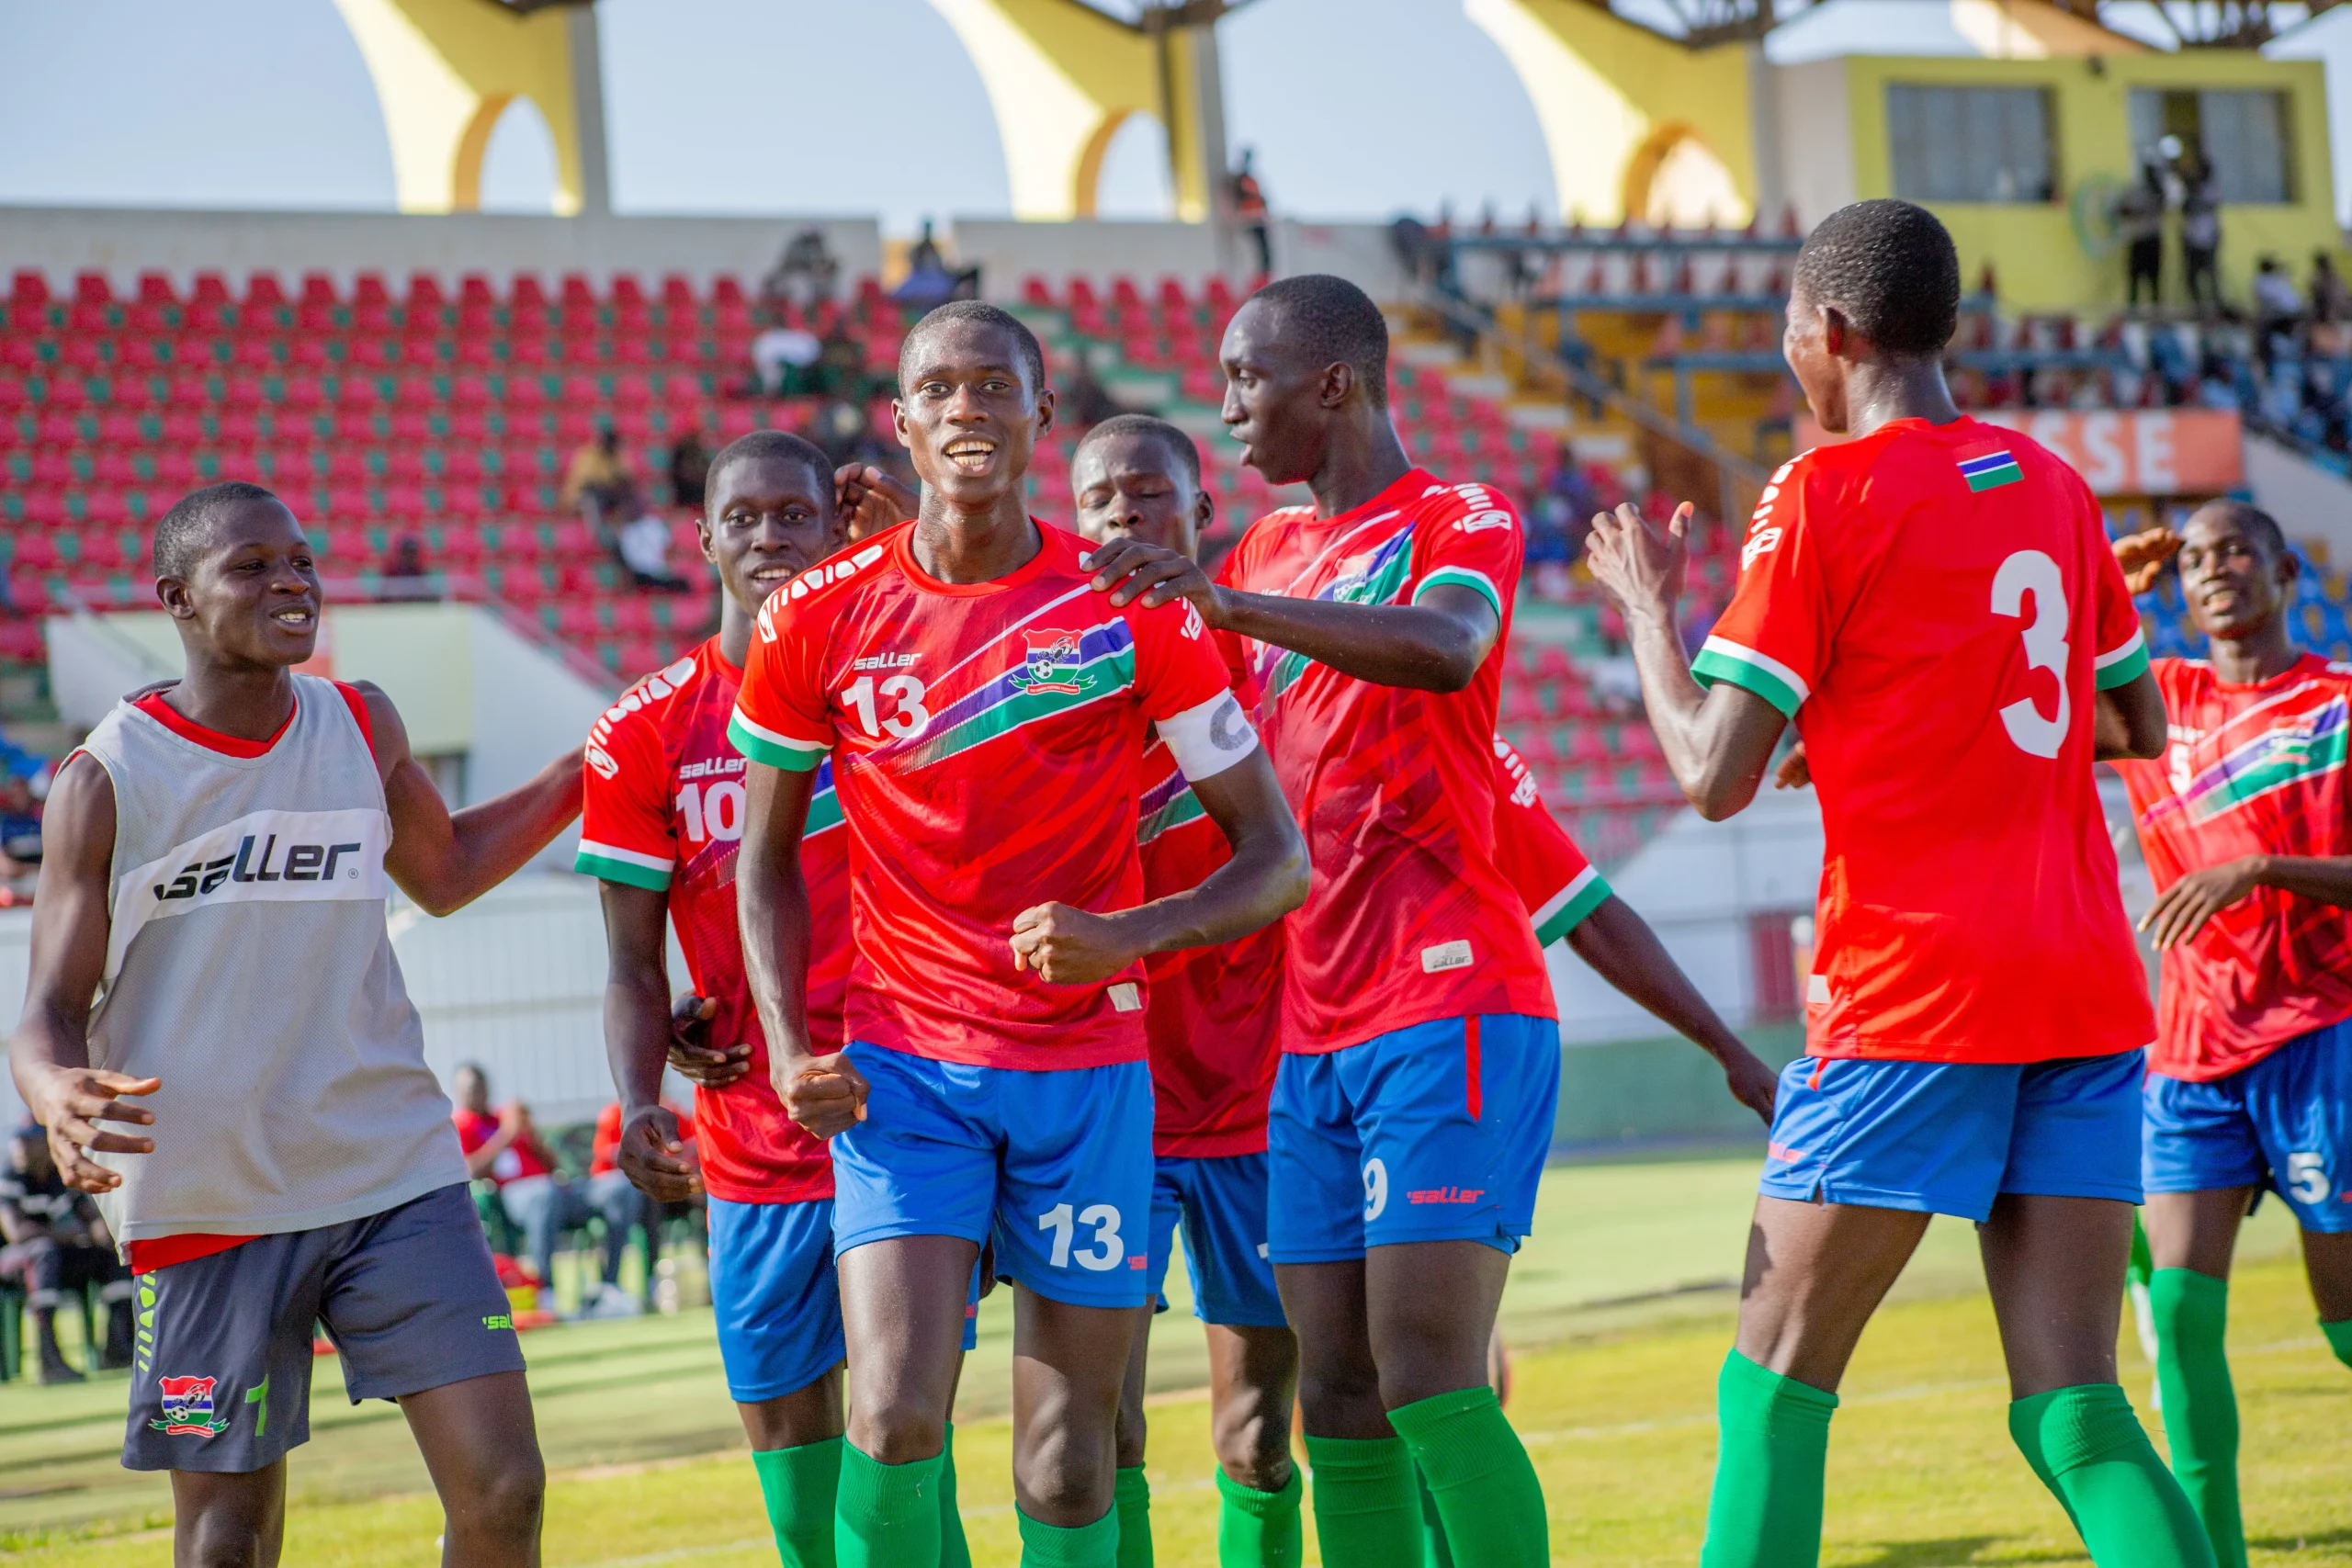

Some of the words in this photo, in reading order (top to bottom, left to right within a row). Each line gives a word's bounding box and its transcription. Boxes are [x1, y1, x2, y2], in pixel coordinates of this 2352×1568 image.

[853, 651, 922, 671] saller
[1990, 549, 2071, 759] 3
[841, 675, 929, 739] 13
[1210, 695, 1252, 750] C
[2169, 742, 2192, 795] 5
[675, 781, 747, 842] 10
[1363, 1157, 1388, 1222] 9
[2288, 1153, 2330, 1205] 5
[1038, 1202, 1125, 1272] 13
